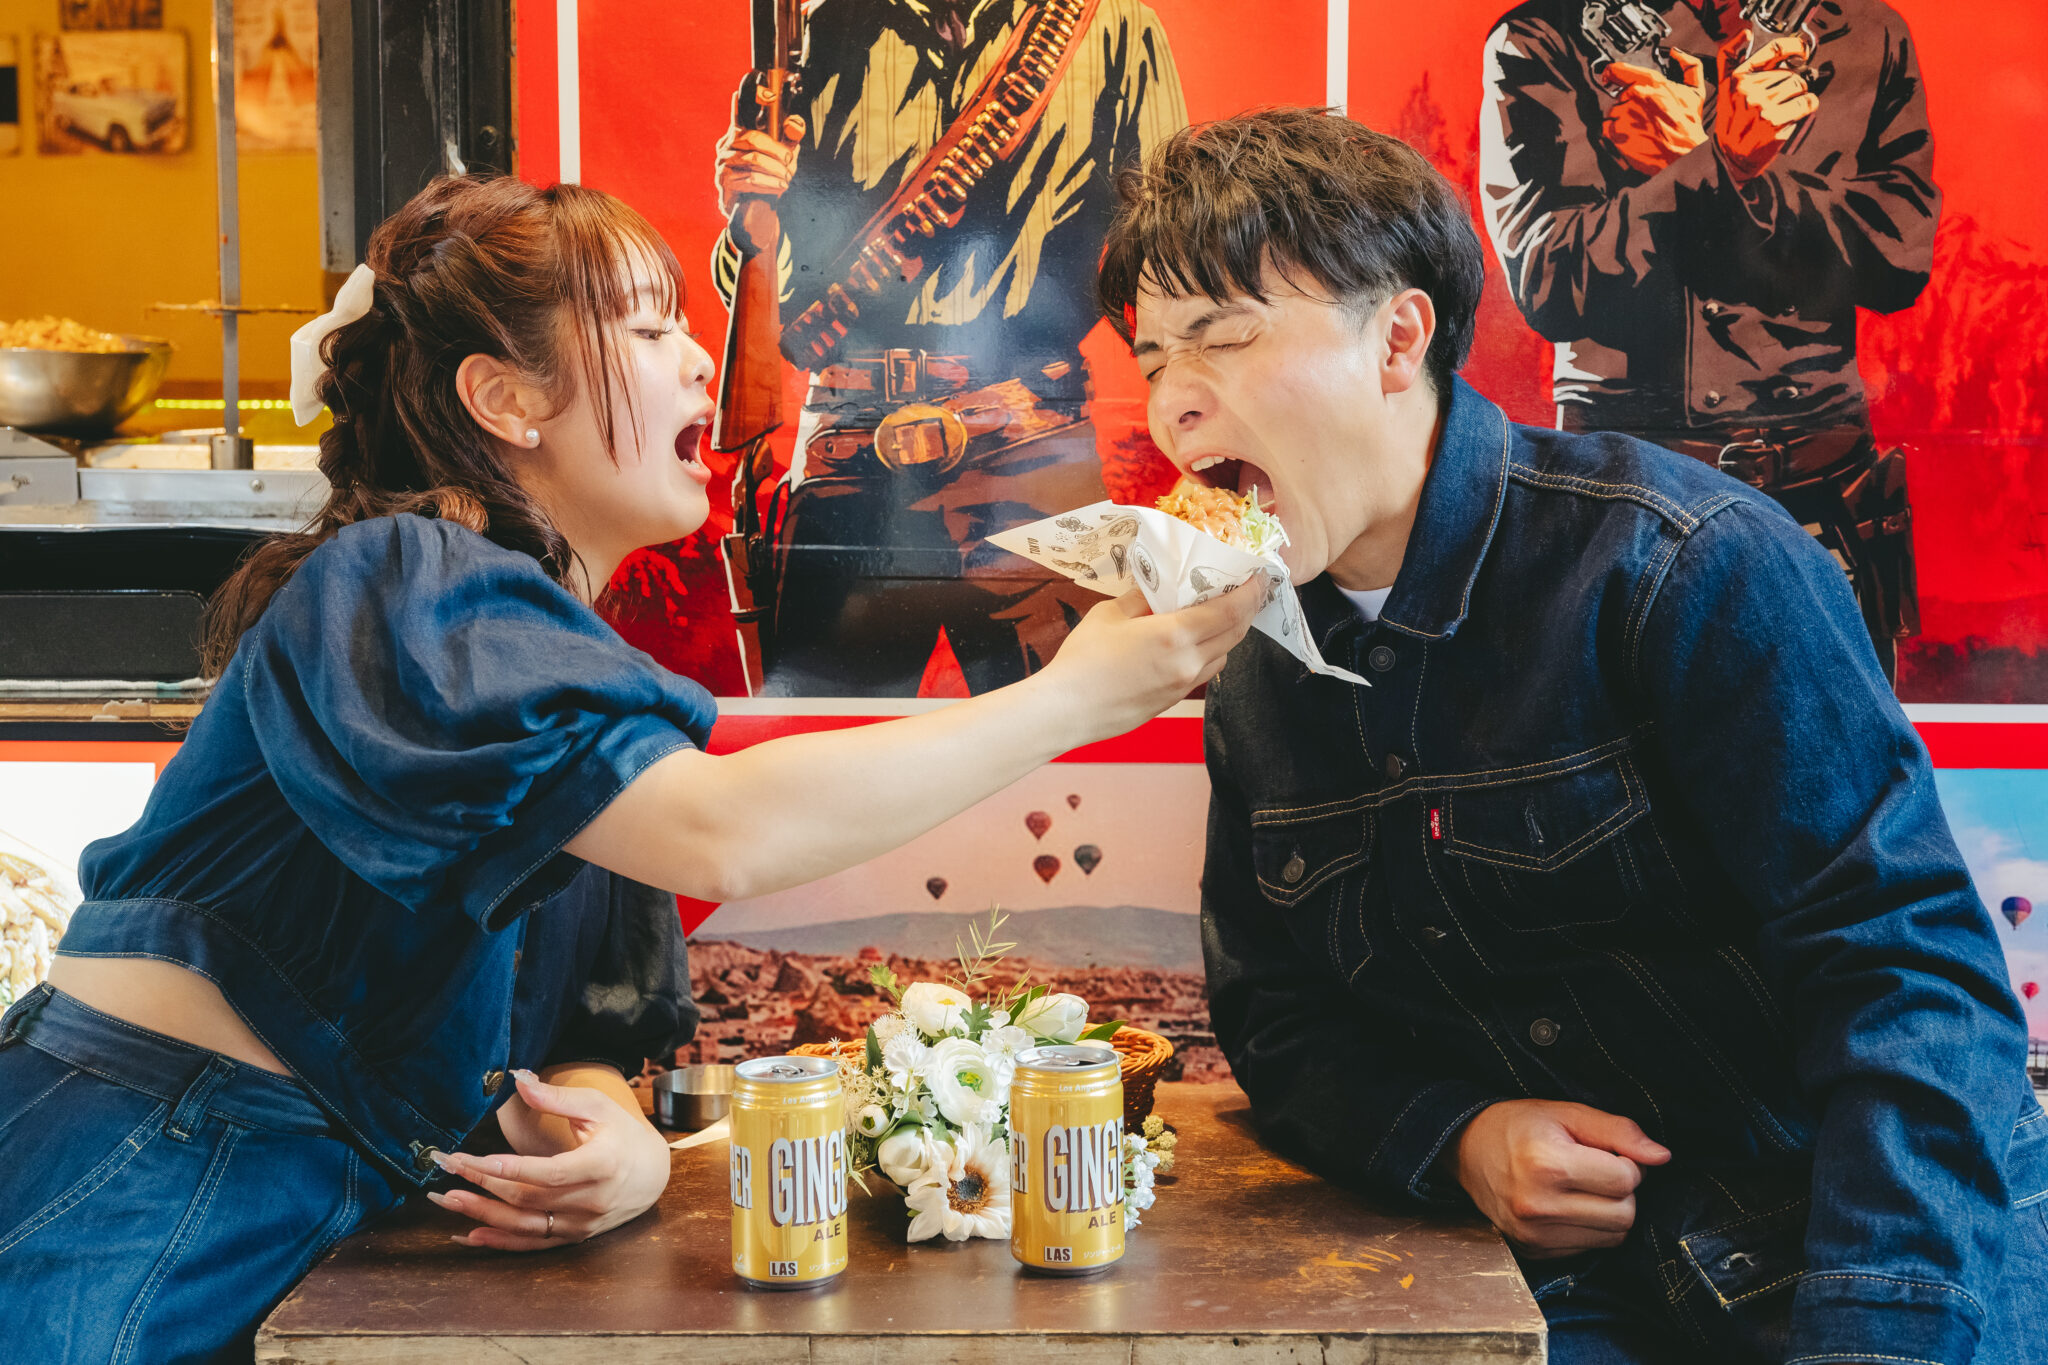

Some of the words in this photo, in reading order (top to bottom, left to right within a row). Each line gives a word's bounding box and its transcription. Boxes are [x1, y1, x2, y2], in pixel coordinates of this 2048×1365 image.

[1027, 537, 1041, 555] TOKYO
[1088, 1211, 1117, 1229] ALE
[813, 1223, 841, 1242] ALE
[1046, 1247, 1071, 1262] LAS
[771, 1262, 797, 1276] LAS
